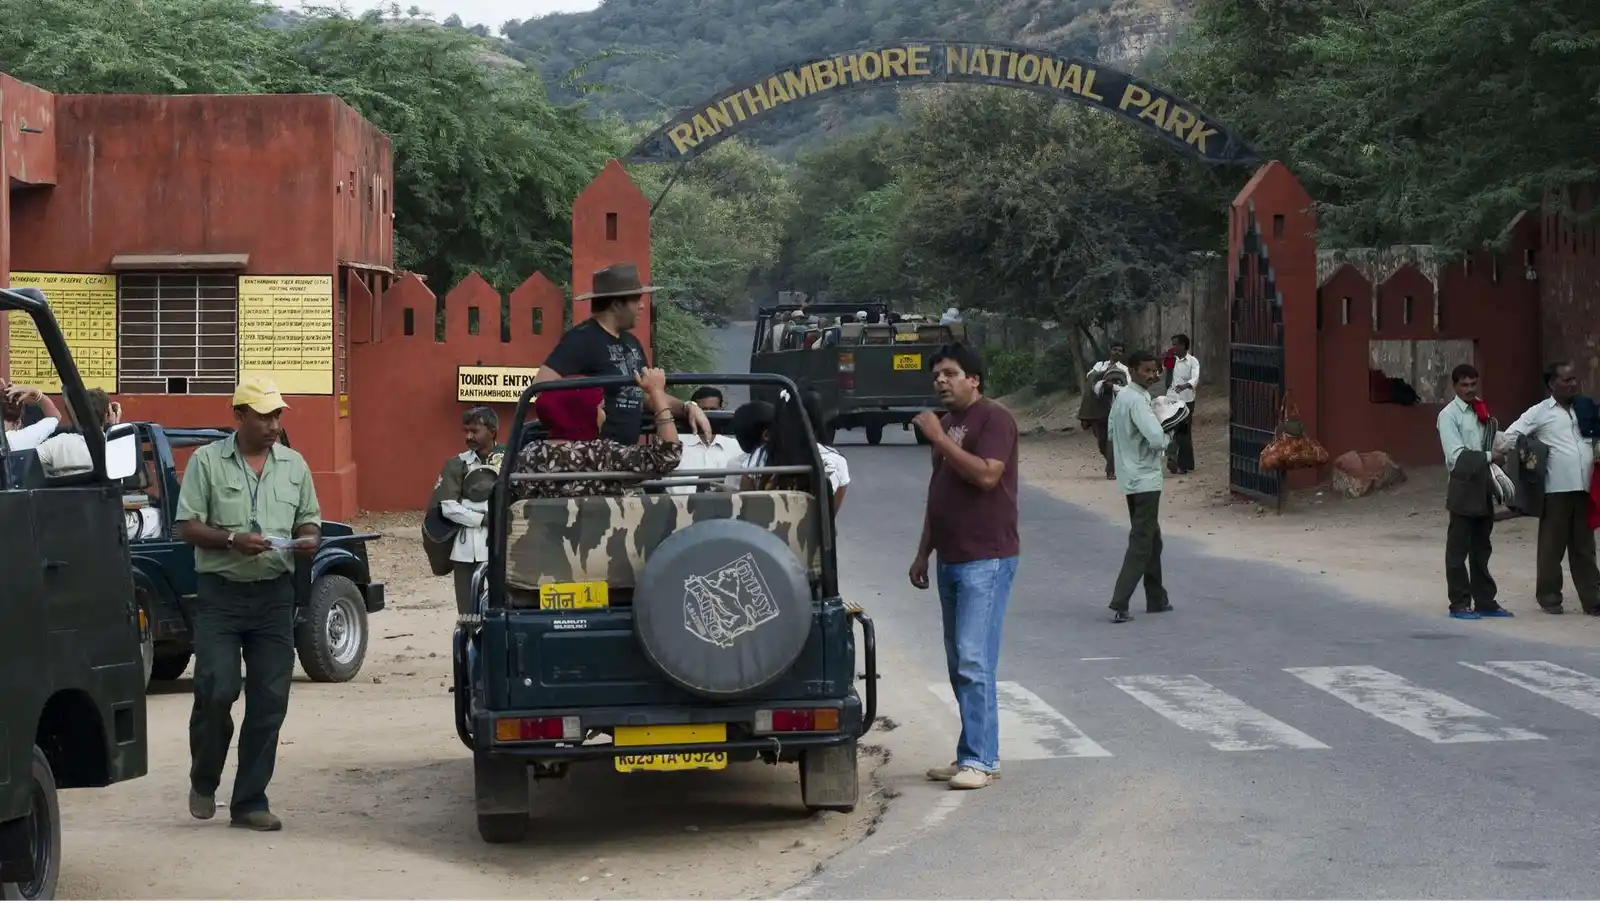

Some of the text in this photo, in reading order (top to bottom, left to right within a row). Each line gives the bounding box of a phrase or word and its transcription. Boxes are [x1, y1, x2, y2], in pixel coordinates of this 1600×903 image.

[668, 46, 1219, 156] RANTHAMBHORE NATIONAL PARK
[460, 374, 535, 387] TOURIST ENTRY
[460, 389, 512, 398] RANTHAMBHORE
[542, 587, 592, 609] जोन 1
[735, 559, 774, 617] GYPSY
[690, 584, 722, 639] KING
